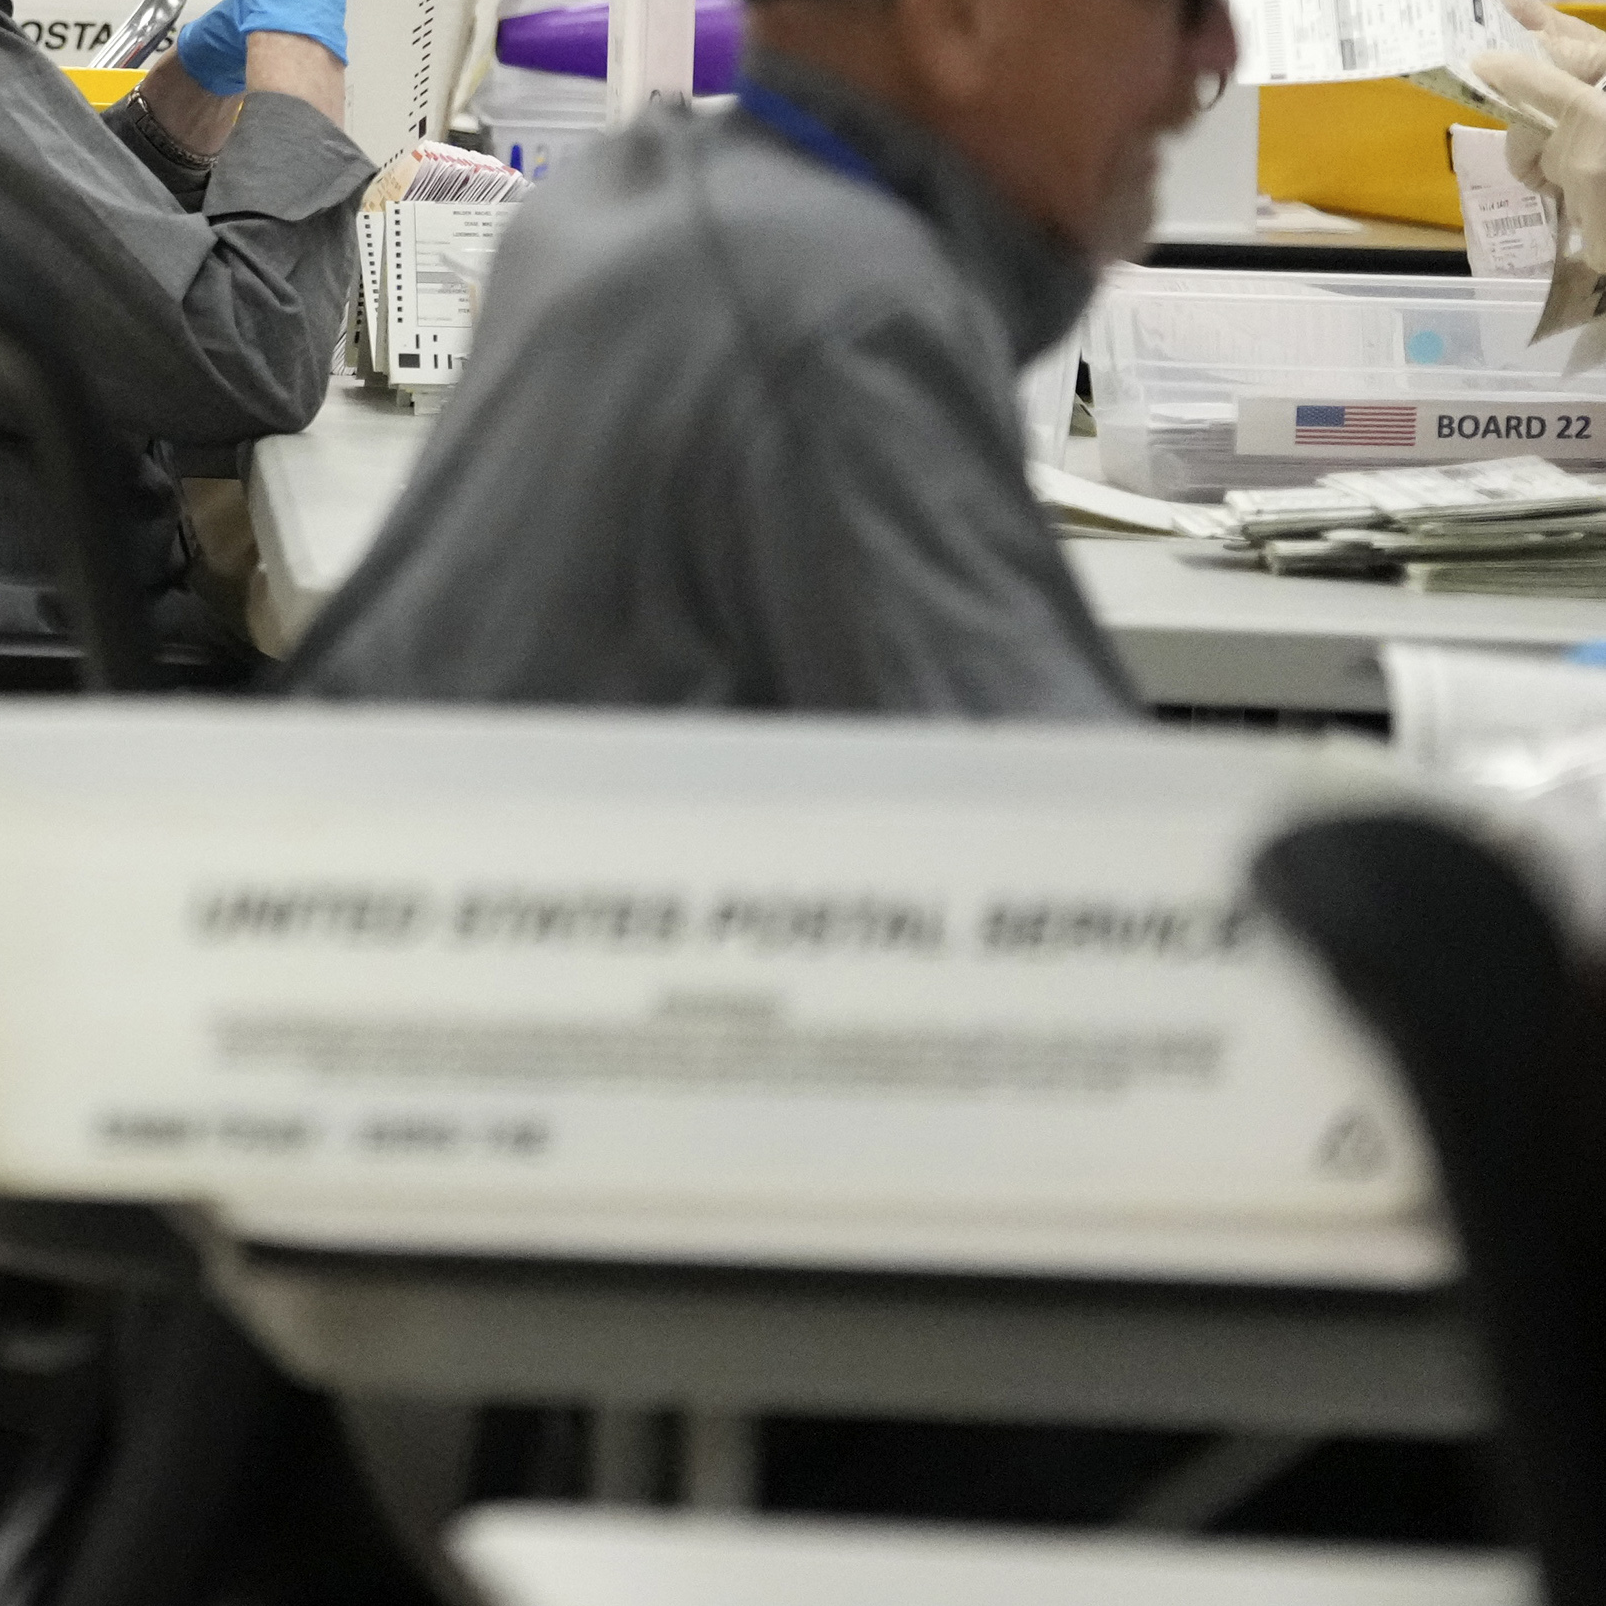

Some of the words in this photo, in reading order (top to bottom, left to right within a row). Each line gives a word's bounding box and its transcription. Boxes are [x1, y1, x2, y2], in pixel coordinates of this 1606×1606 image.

[17, 18, 114, 51] OSTA
[1438, 415, 1547, 440] BOARD
[1557, 416, 1592, 440] 22
